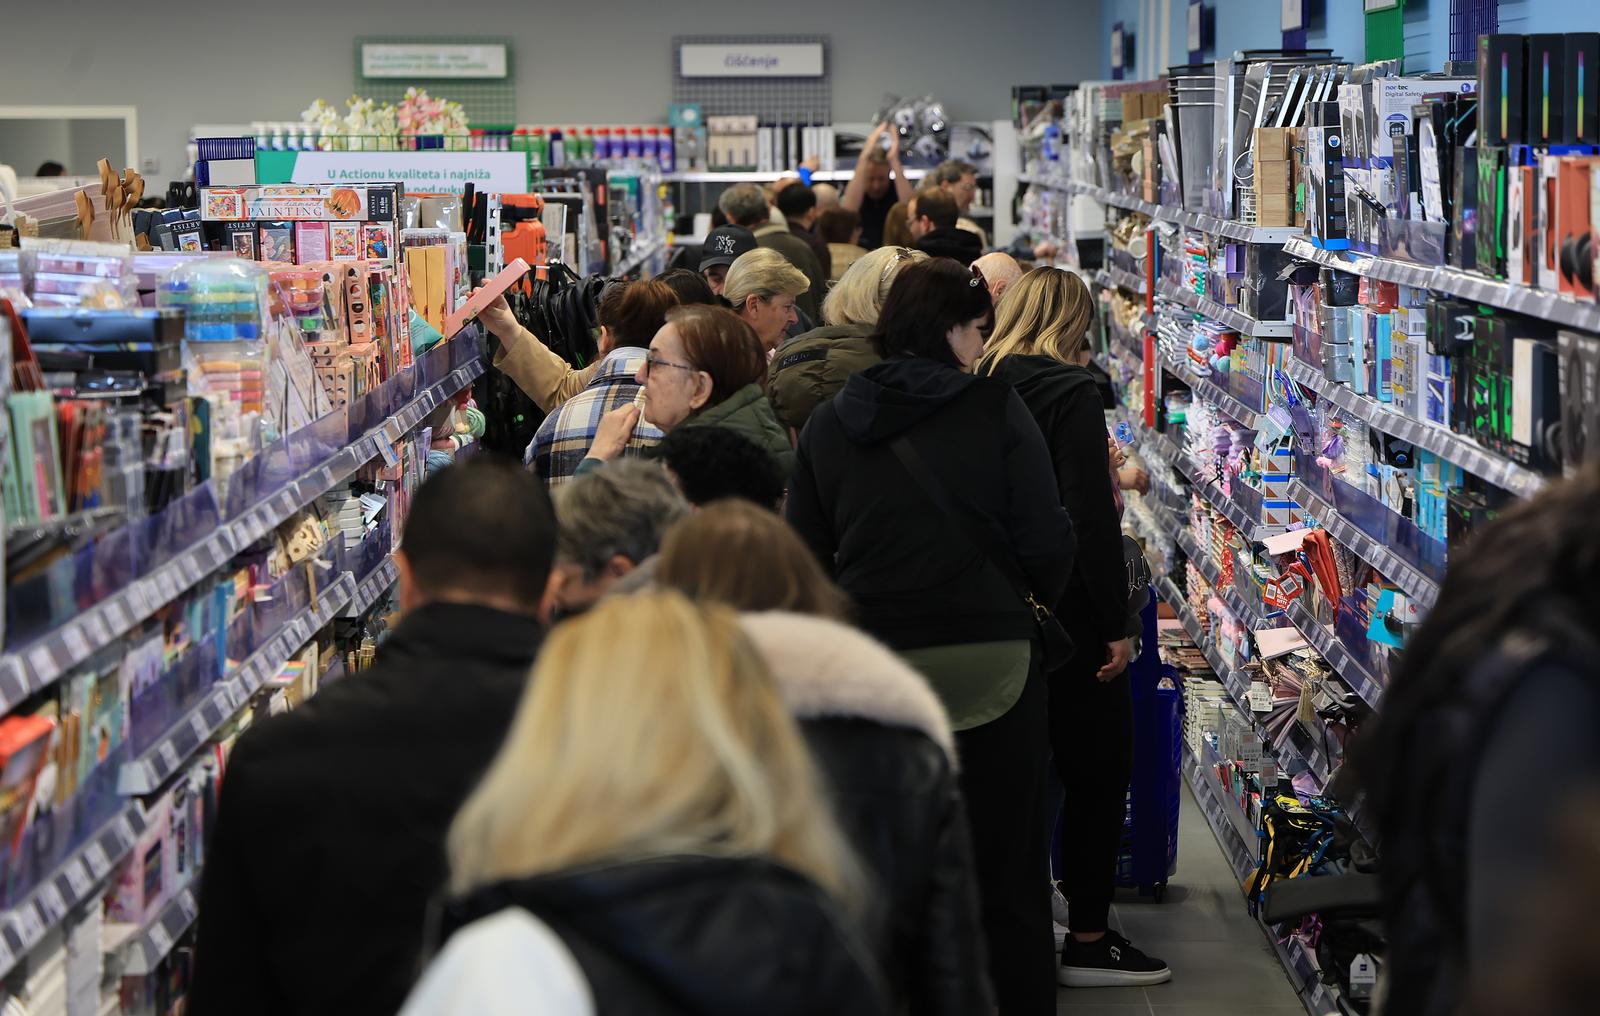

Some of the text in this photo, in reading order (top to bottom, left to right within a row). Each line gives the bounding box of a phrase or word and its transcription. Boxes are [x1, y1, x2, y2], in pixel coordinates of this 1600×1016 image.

[327, 168, 491, 182] U Actionu kvaliteta i najniža
[248, 207, 322, 217] PAINTING
